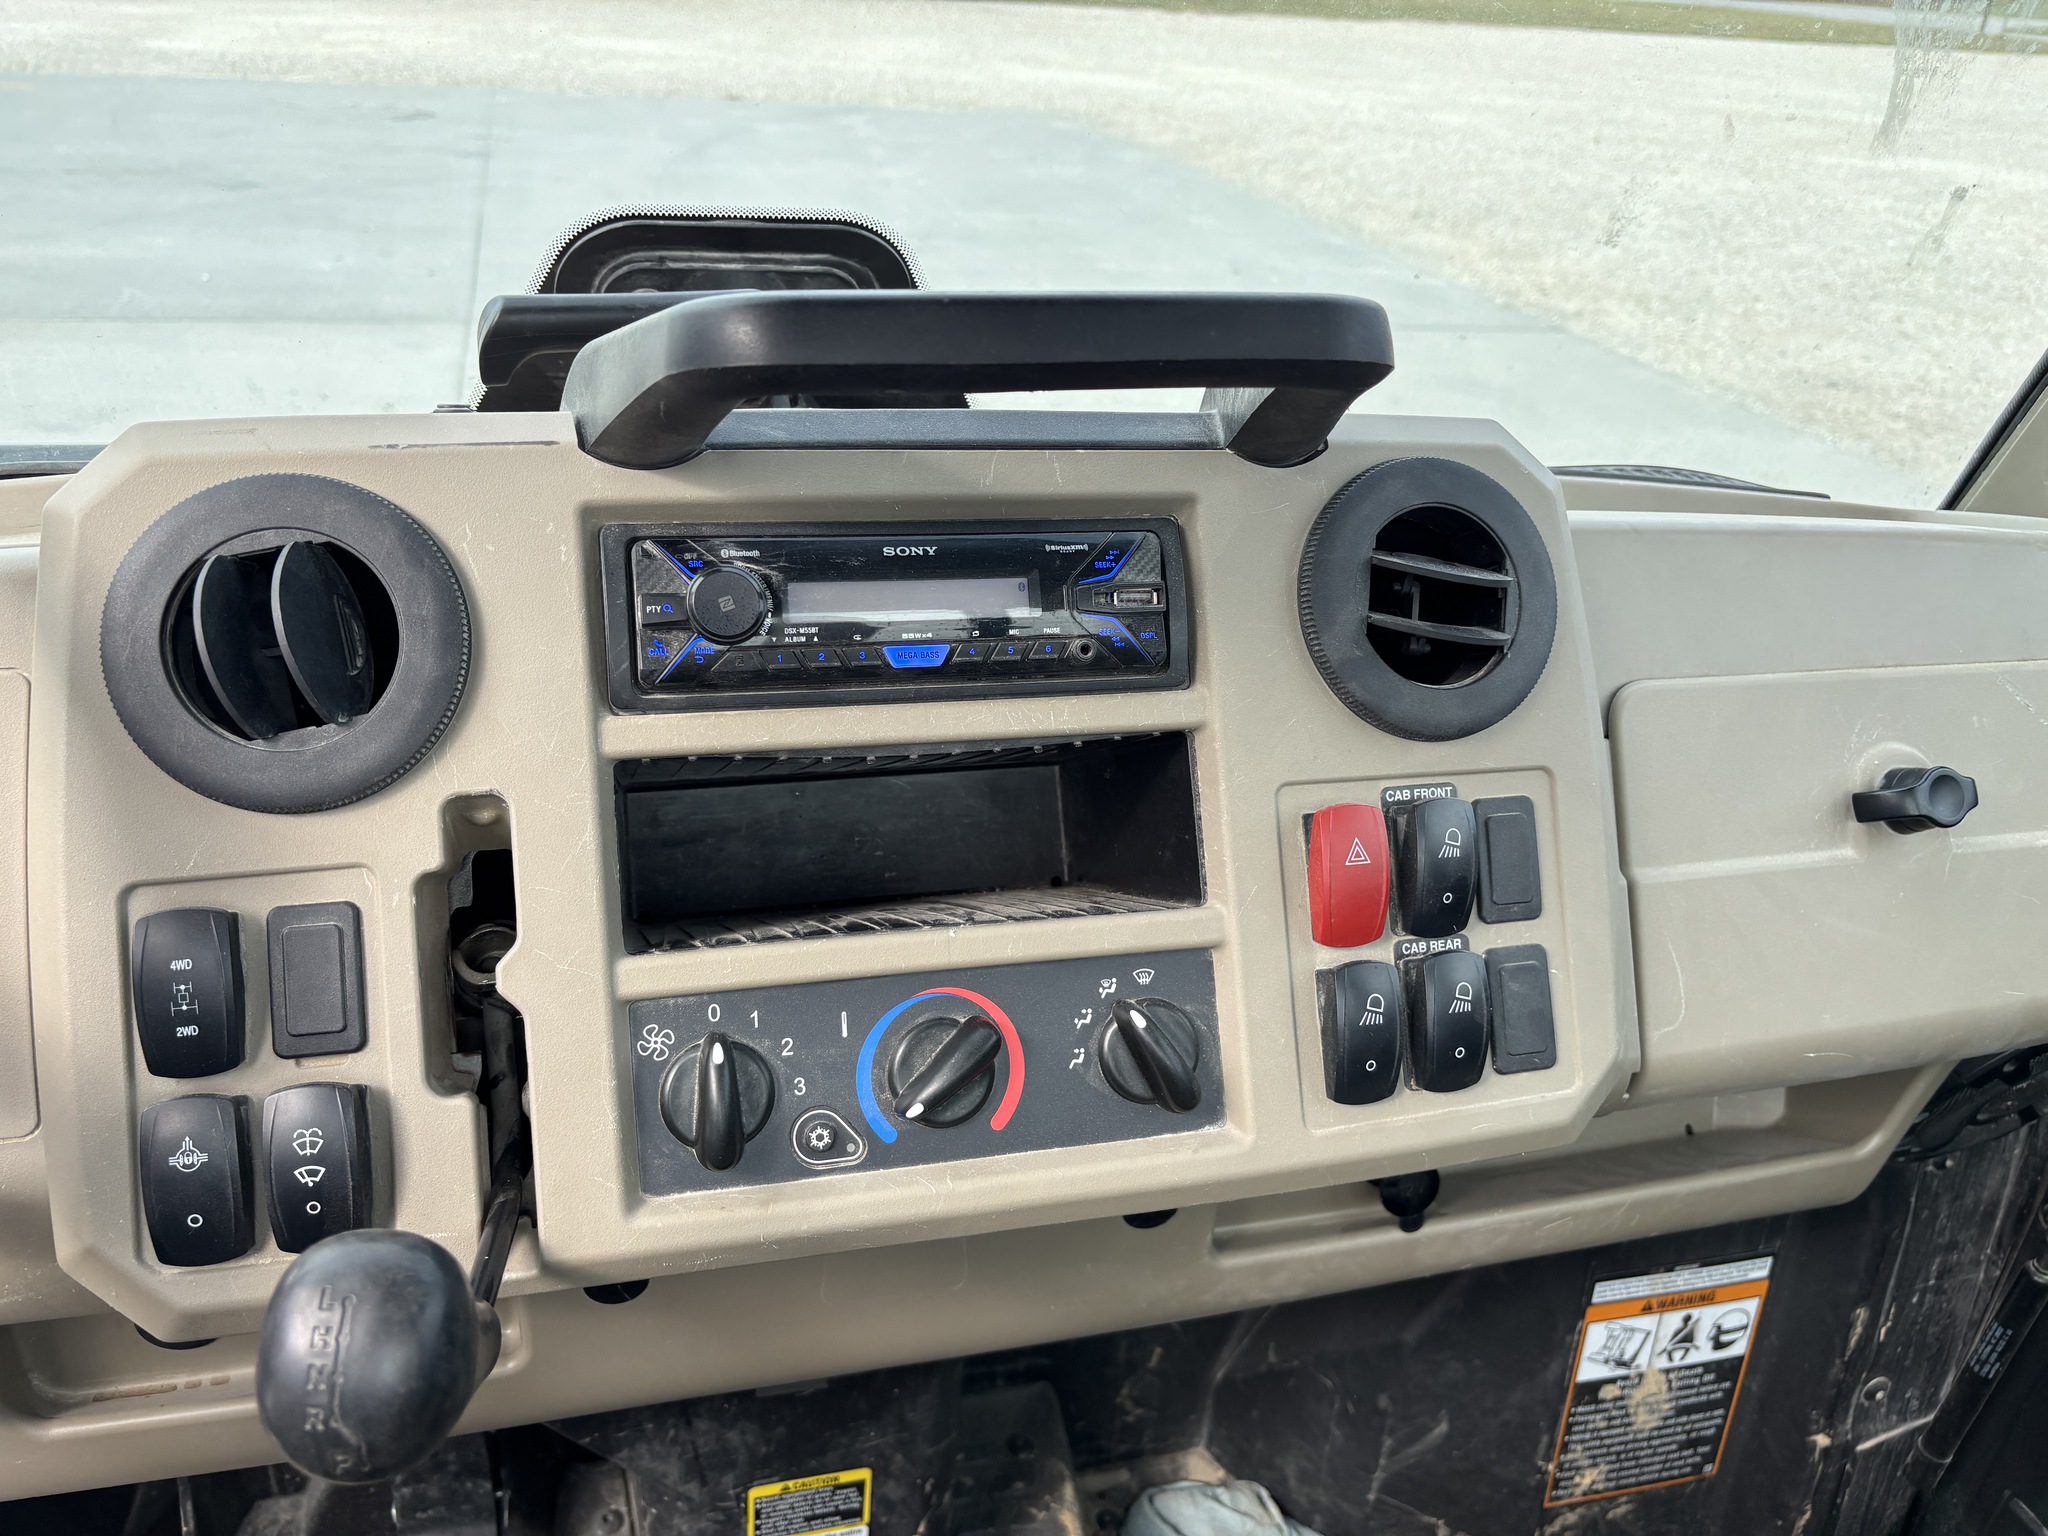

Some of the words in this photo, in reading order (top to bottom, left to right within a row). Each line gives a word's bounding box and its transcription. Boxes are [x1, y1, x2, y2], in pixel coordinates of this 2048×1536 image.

[729, 549, 761, 558] Bluetooth
[882, 546, 938, 557] SONY
[688, 560, 704, 568] SRC
[1094, 561, 1117, 569] SEEK+
[646, 605, 662, 614] PTY
[648, 648, 669, 656] CALL
[694, 647, 715, 655] MODE
[897, 651, 919, 659] MEGA
[920, 651, 940, 659] BASS
[1007, 646, 1014, 654] 5
[1045, 645, 1052, 653] 6
[777, 654, 783, 662] 1
[818, 652, 825, 661] 2
[859, 651, 866, 660] 3
[1385, 789, 1411, 802] CAB
[1413, 786, 1453, 800] FRONT
[1401, 941, 1427, 955] CAB
[1429, 938, 1462, 952] REAR
[170, 958, 193, 971] 4WD
[707, 1003, 721, 1022] 0
[749, 1010, 760, 1029] 1
[176, 1025, 199, 1038] 2WD
[781, 1037, 794, 1056] 2
[793, 1077, 806, 1096] 3
[318, 1284, 336, 1312] L
[1656, 1290, 1717, 1311] WARNING
[306, 1363, 329, 1391] N
[304, 1406, 325, 1432] R
[791, 1474, 840, 1491] CAUTION
